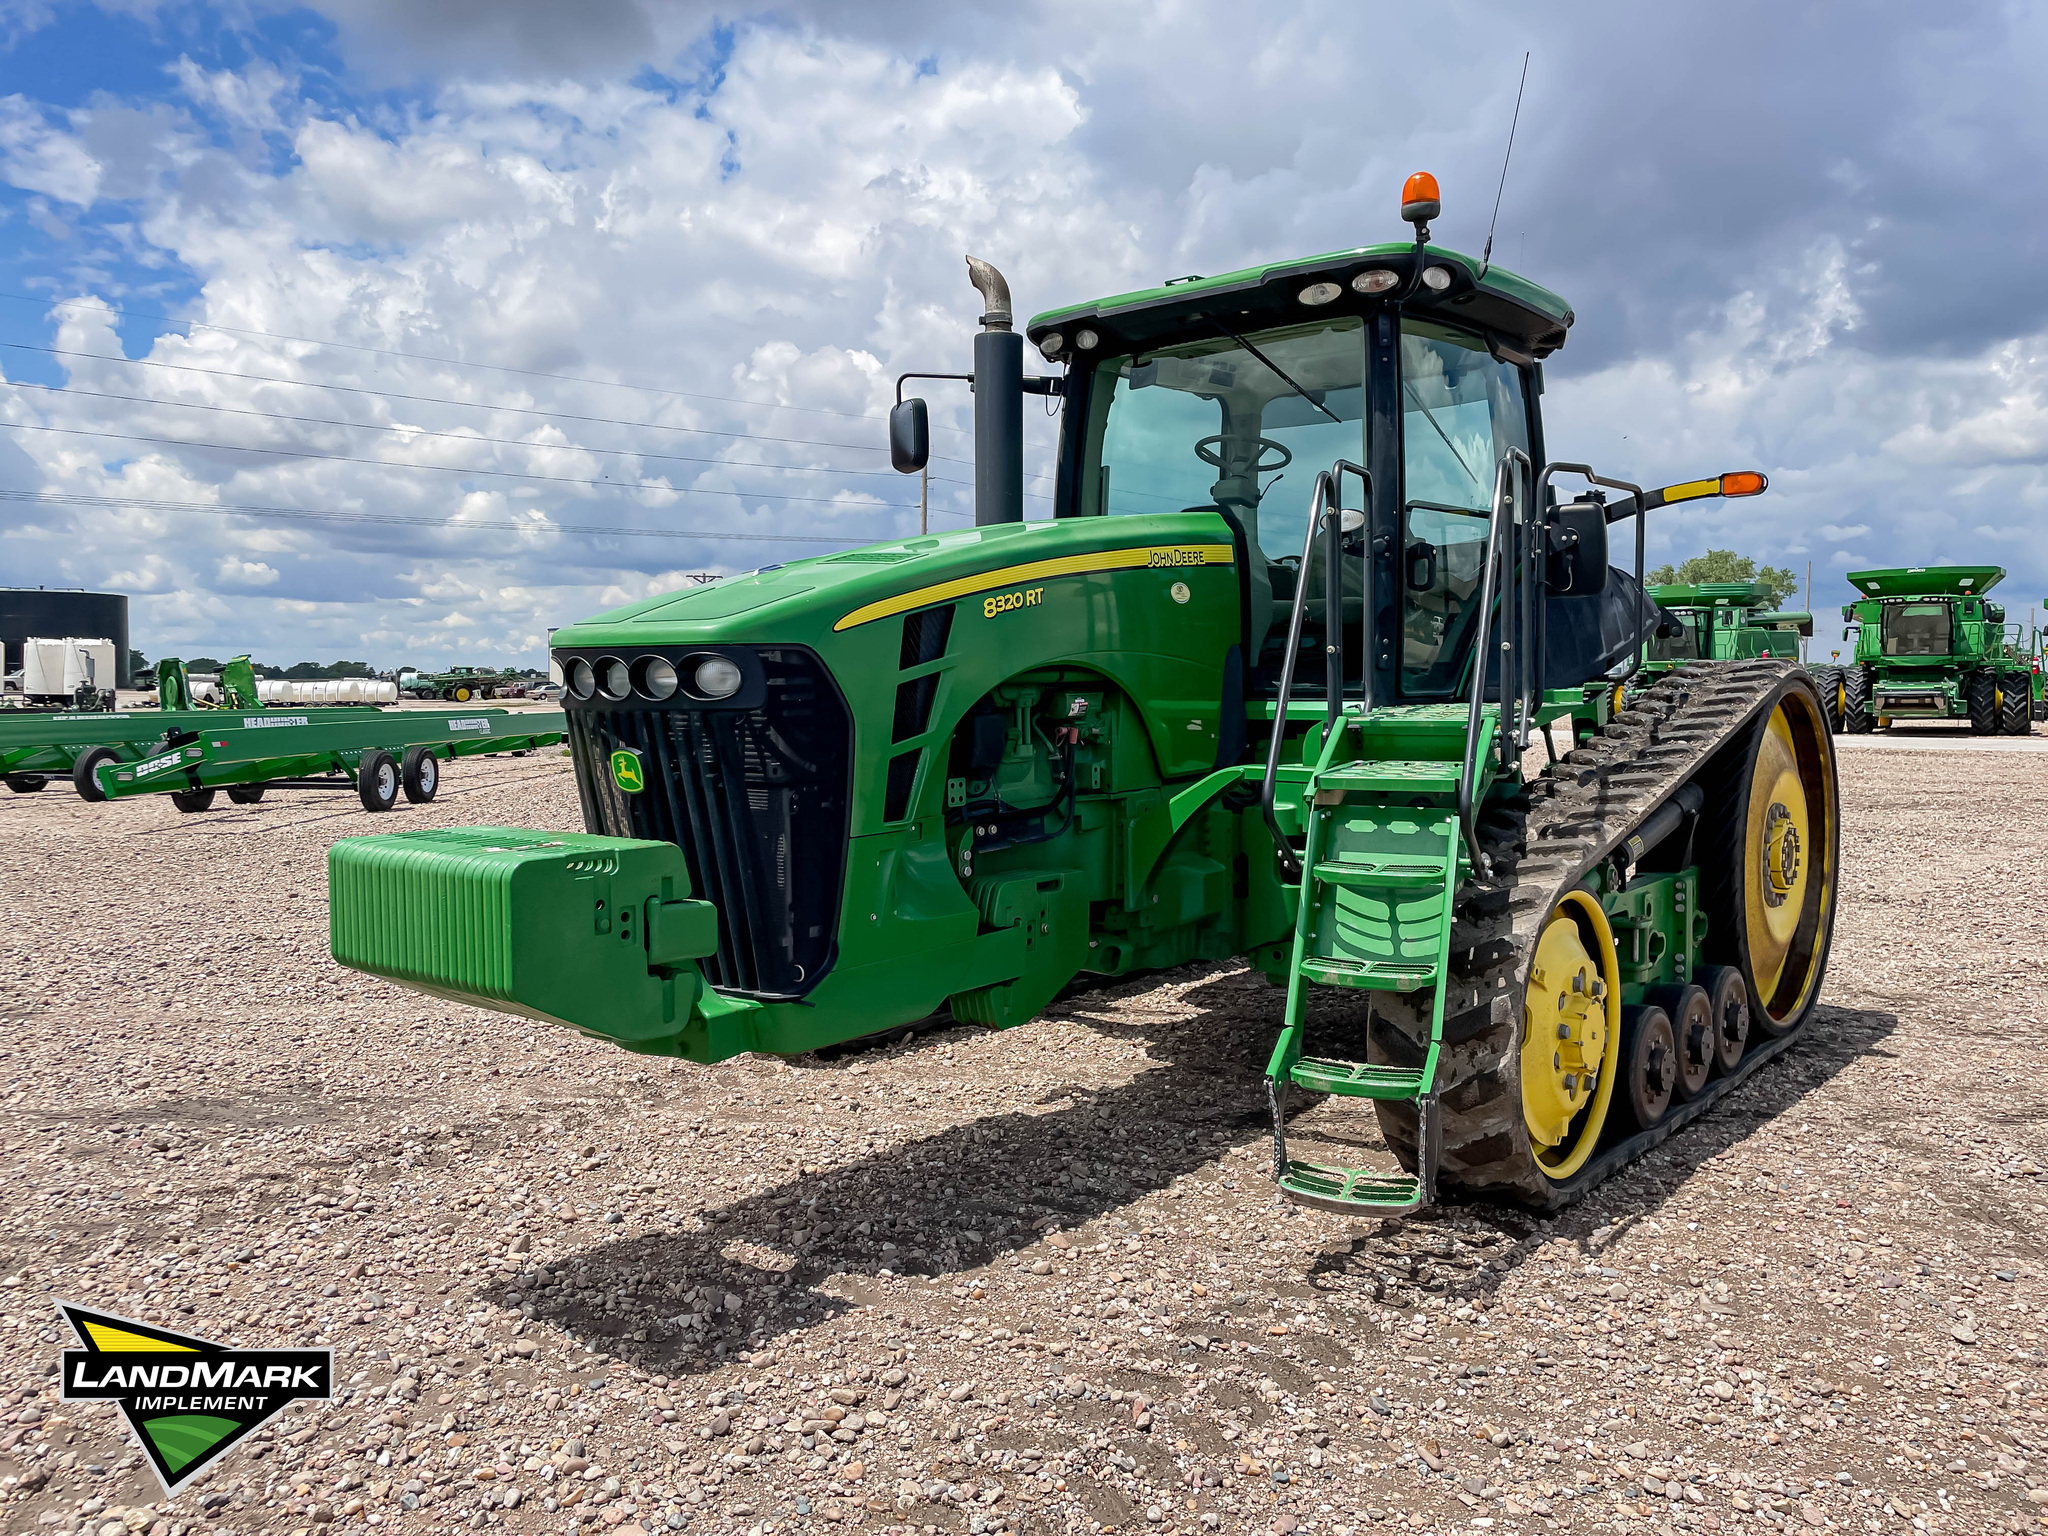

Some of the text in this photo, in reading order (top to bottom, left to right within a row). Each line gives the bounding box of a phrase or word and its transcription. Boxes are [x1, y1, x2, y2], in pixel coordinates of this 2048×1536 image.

[1147, 548, 1205, 567] JOHN DEERE
[983, 587, 1044, 619] 8320 RT
